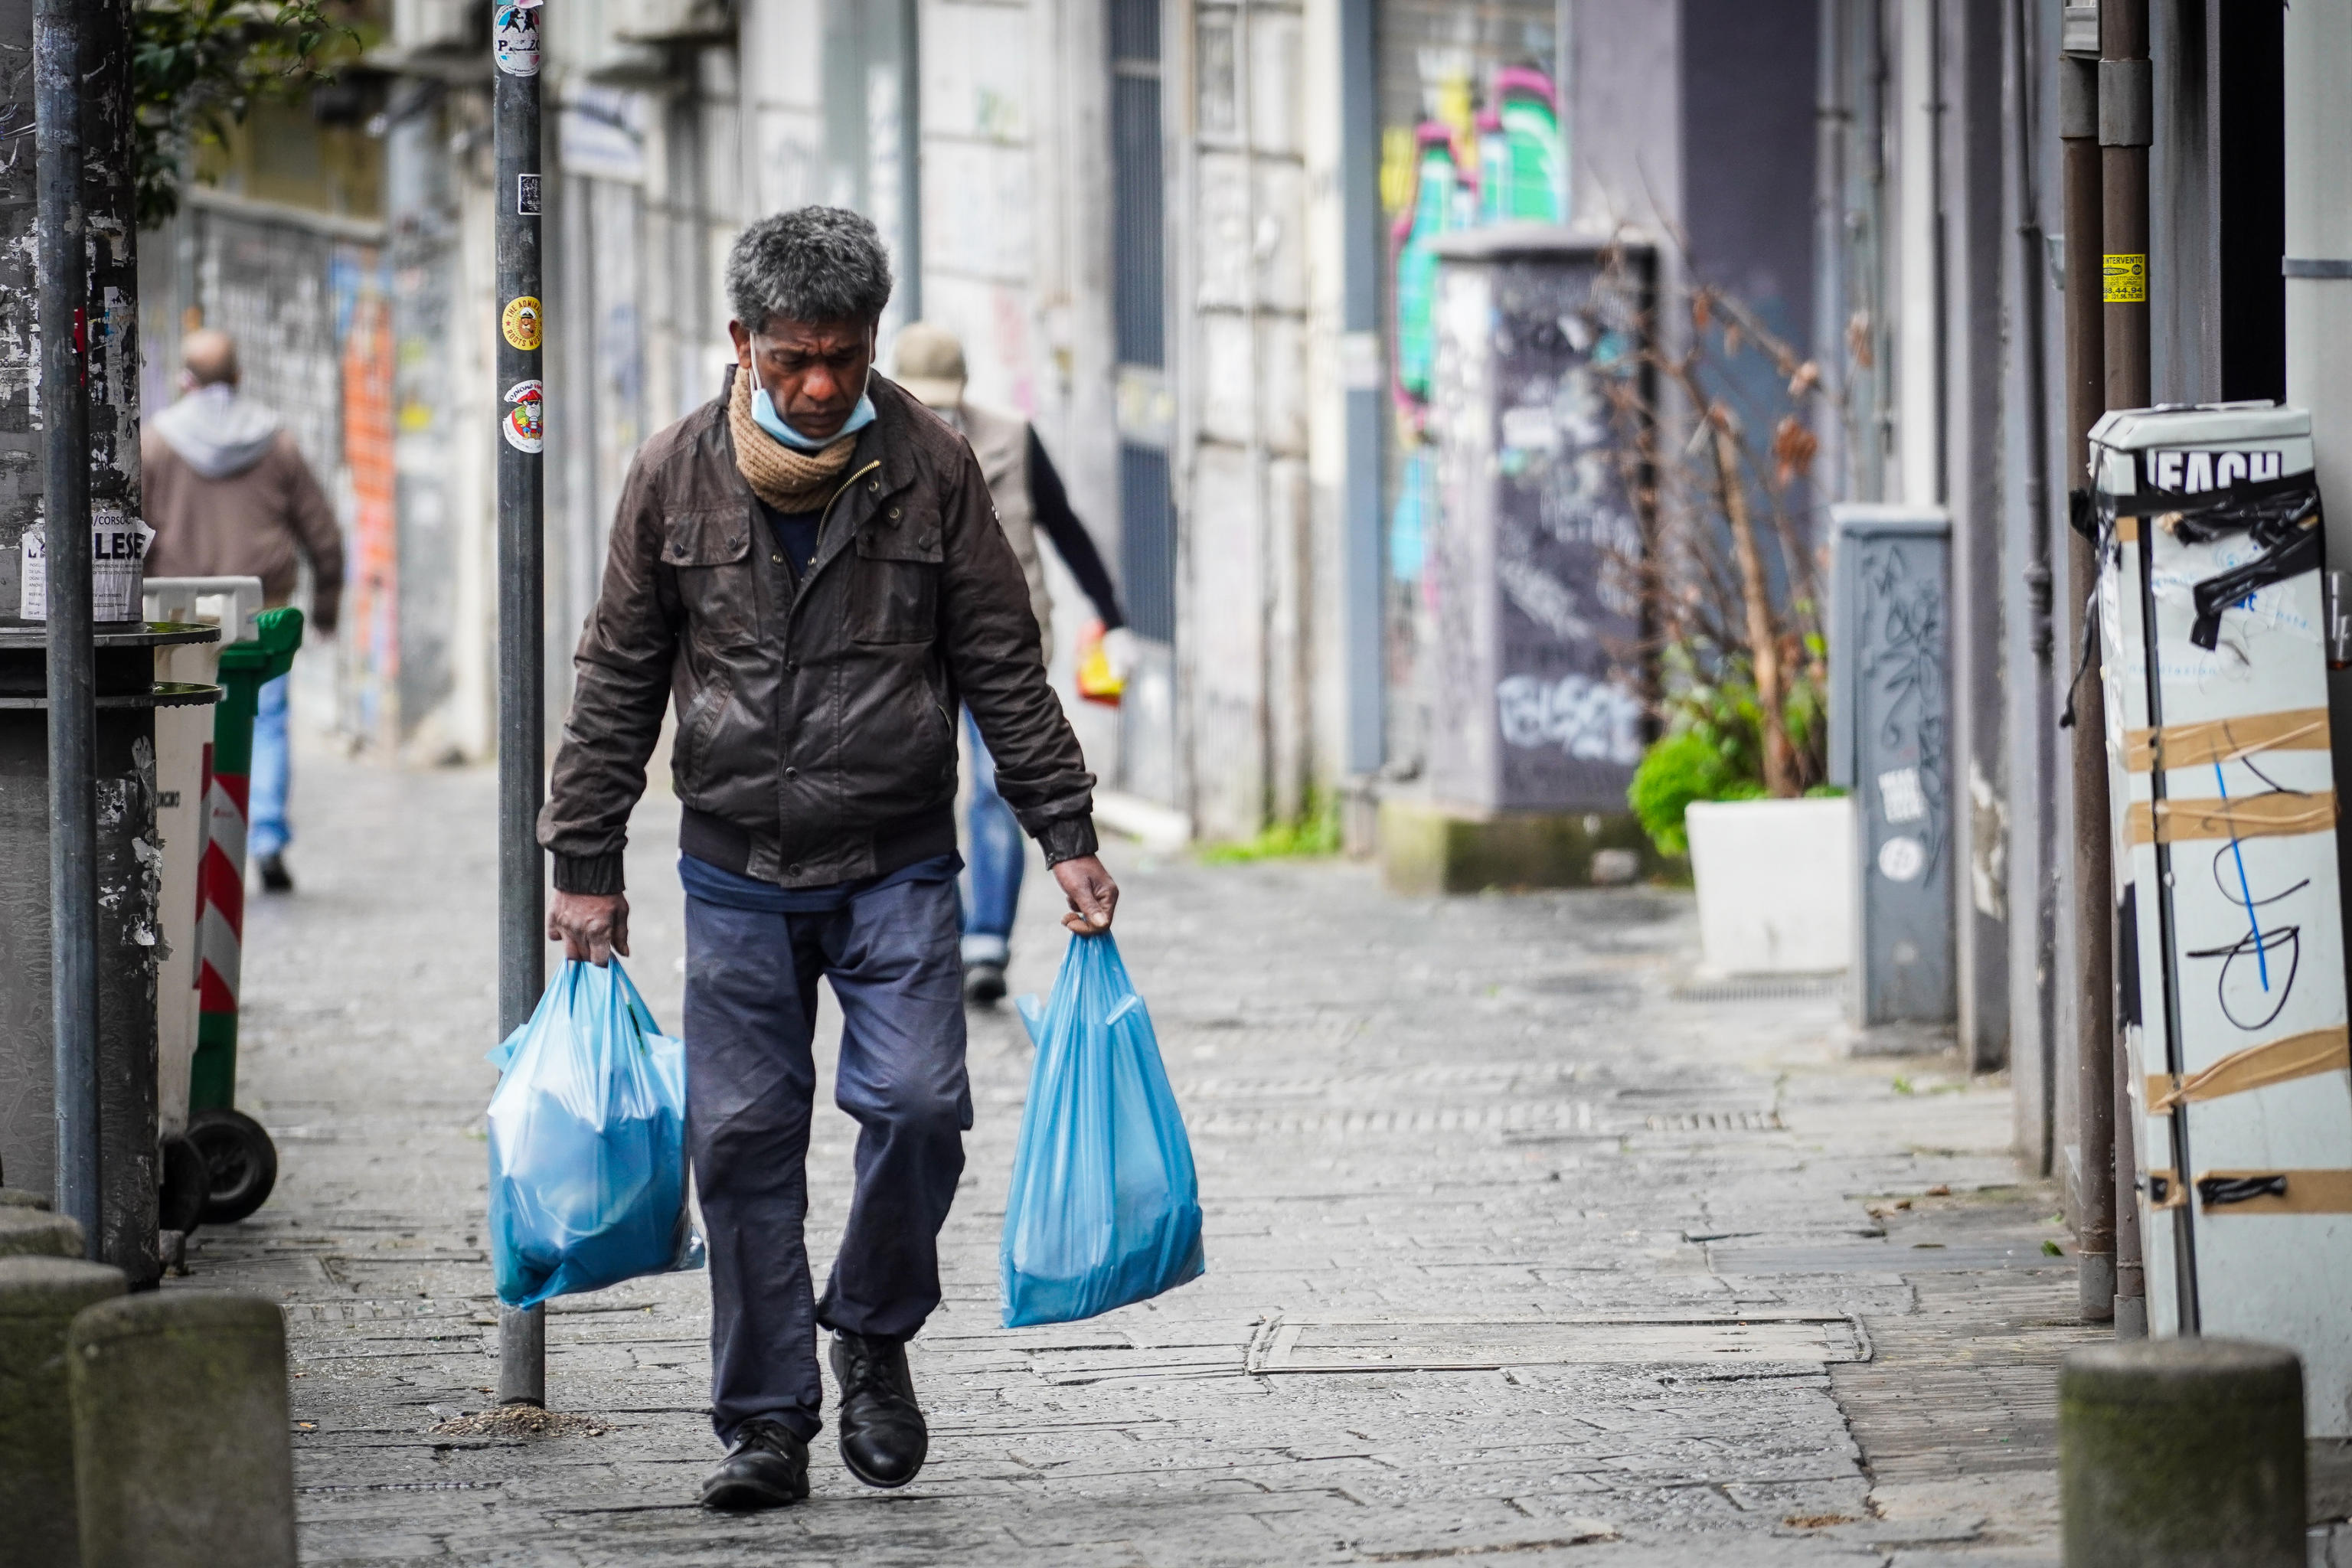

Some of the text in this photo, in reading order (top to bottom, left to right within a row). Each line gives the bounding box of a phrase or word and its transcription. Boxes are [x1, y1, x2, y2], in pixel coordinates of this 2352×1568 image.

[507, 305, 518, 318] THE
[507, 329, 527, 347] ROOTS
[95, 532, 147, 560] LESE
